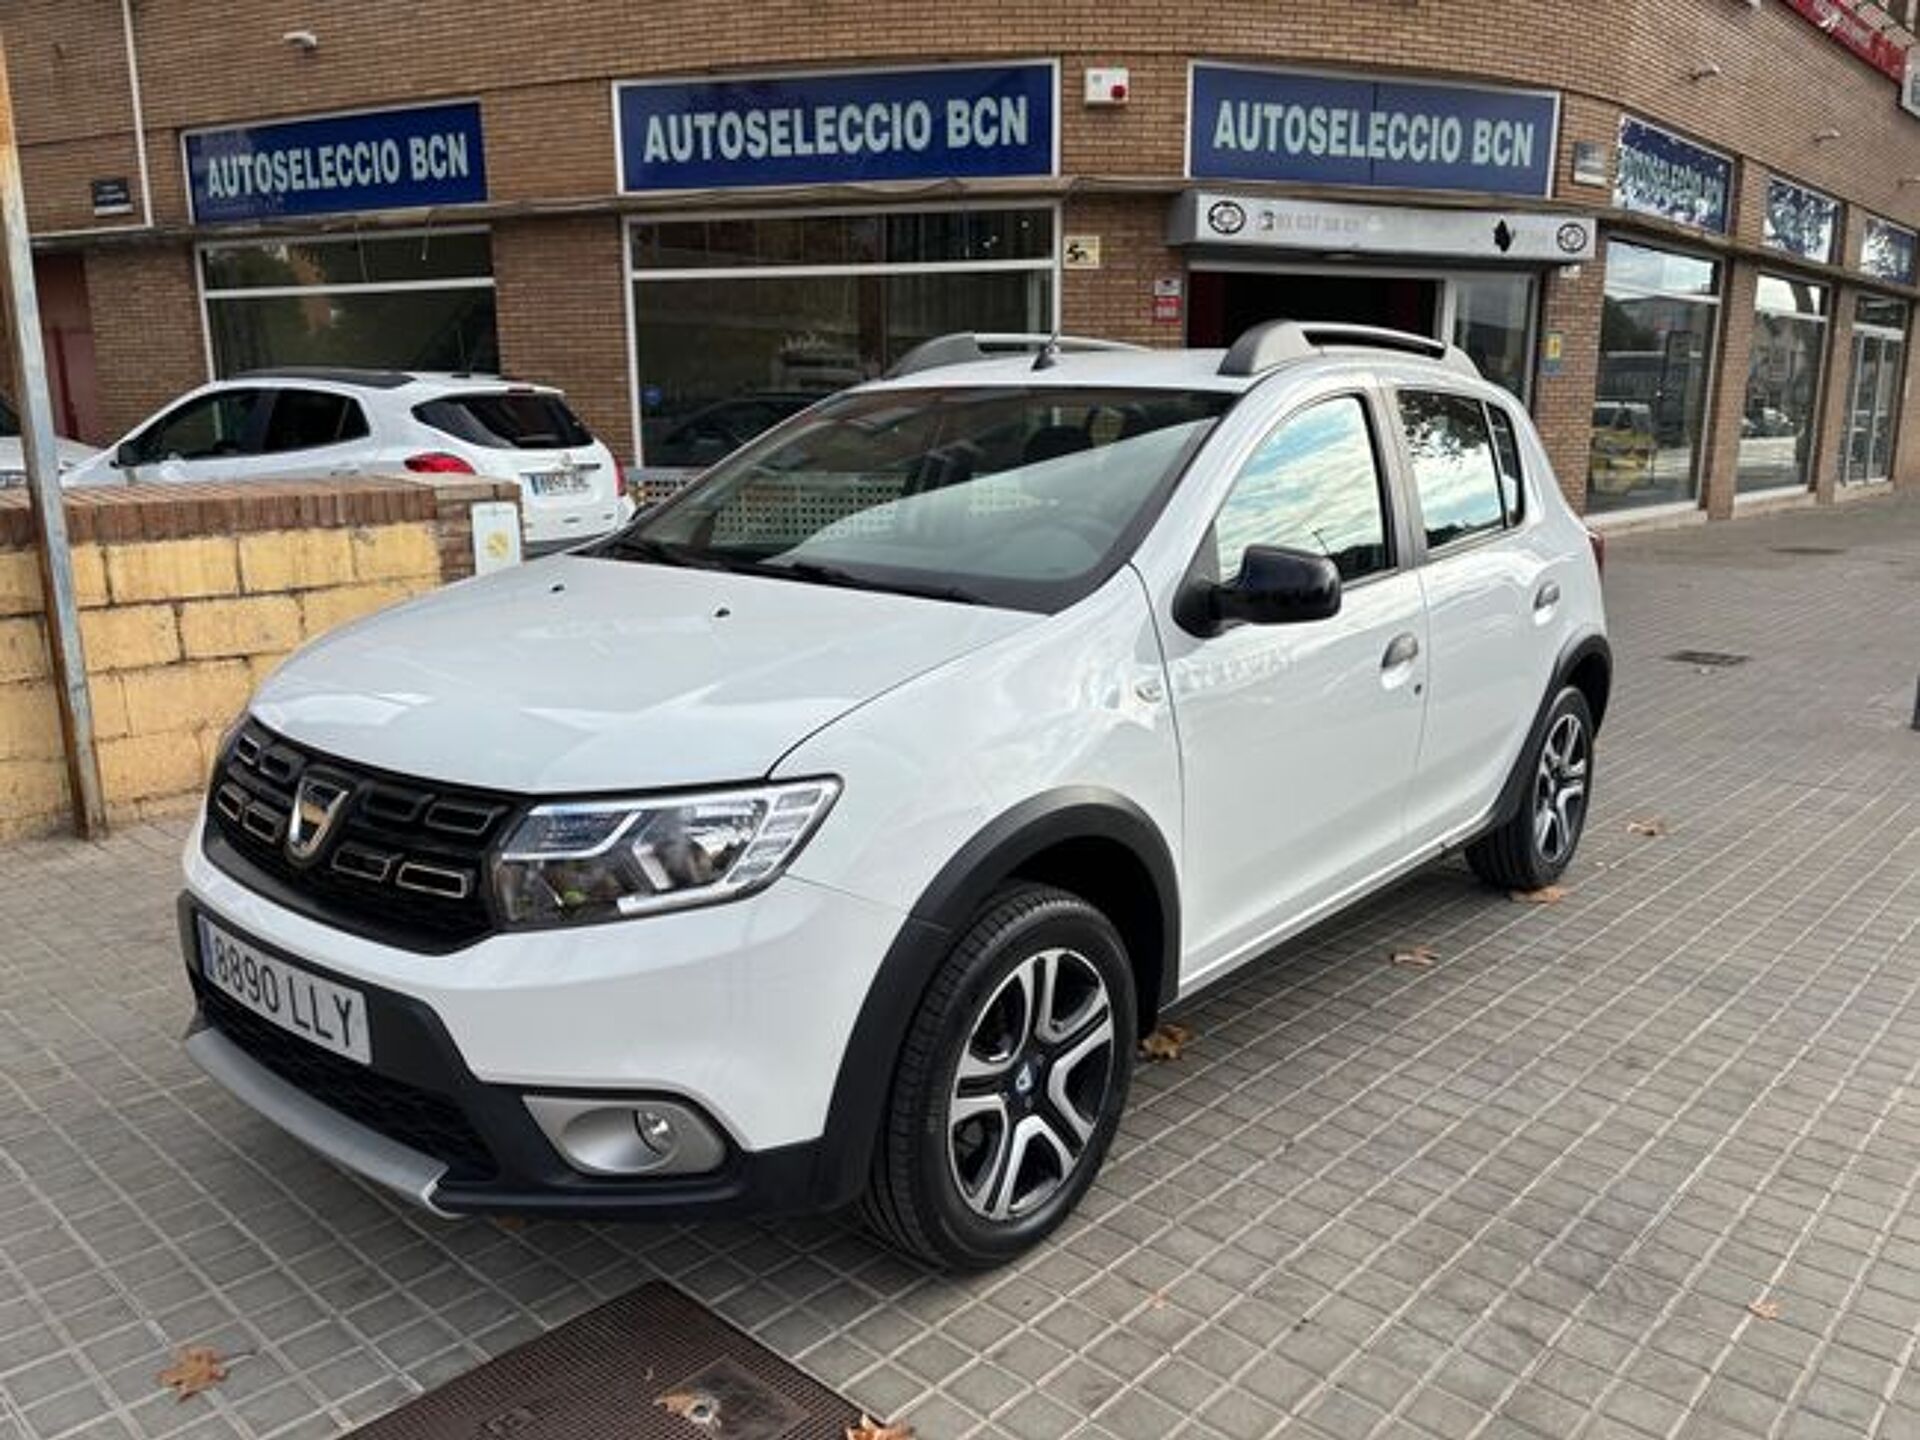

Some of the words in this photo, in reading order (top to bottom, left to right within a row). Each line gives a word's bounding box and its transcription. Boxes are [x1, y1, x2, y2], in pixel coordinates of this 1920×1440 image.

[643, 100, 932, 163] AUTOSELECCIO
[947, 95, 1029, 149] BCN
[1213, 99, 1463, 164] AUTOSELECCIO
[1471, 118, 1535, 168] BCN
[208, 137, 400, 198] AUTOSELECCIO
[408, 131, 469, 181] BCN
[214, 934, 282, 1014] 8890
[288, 975, 352, 1049] LLY
